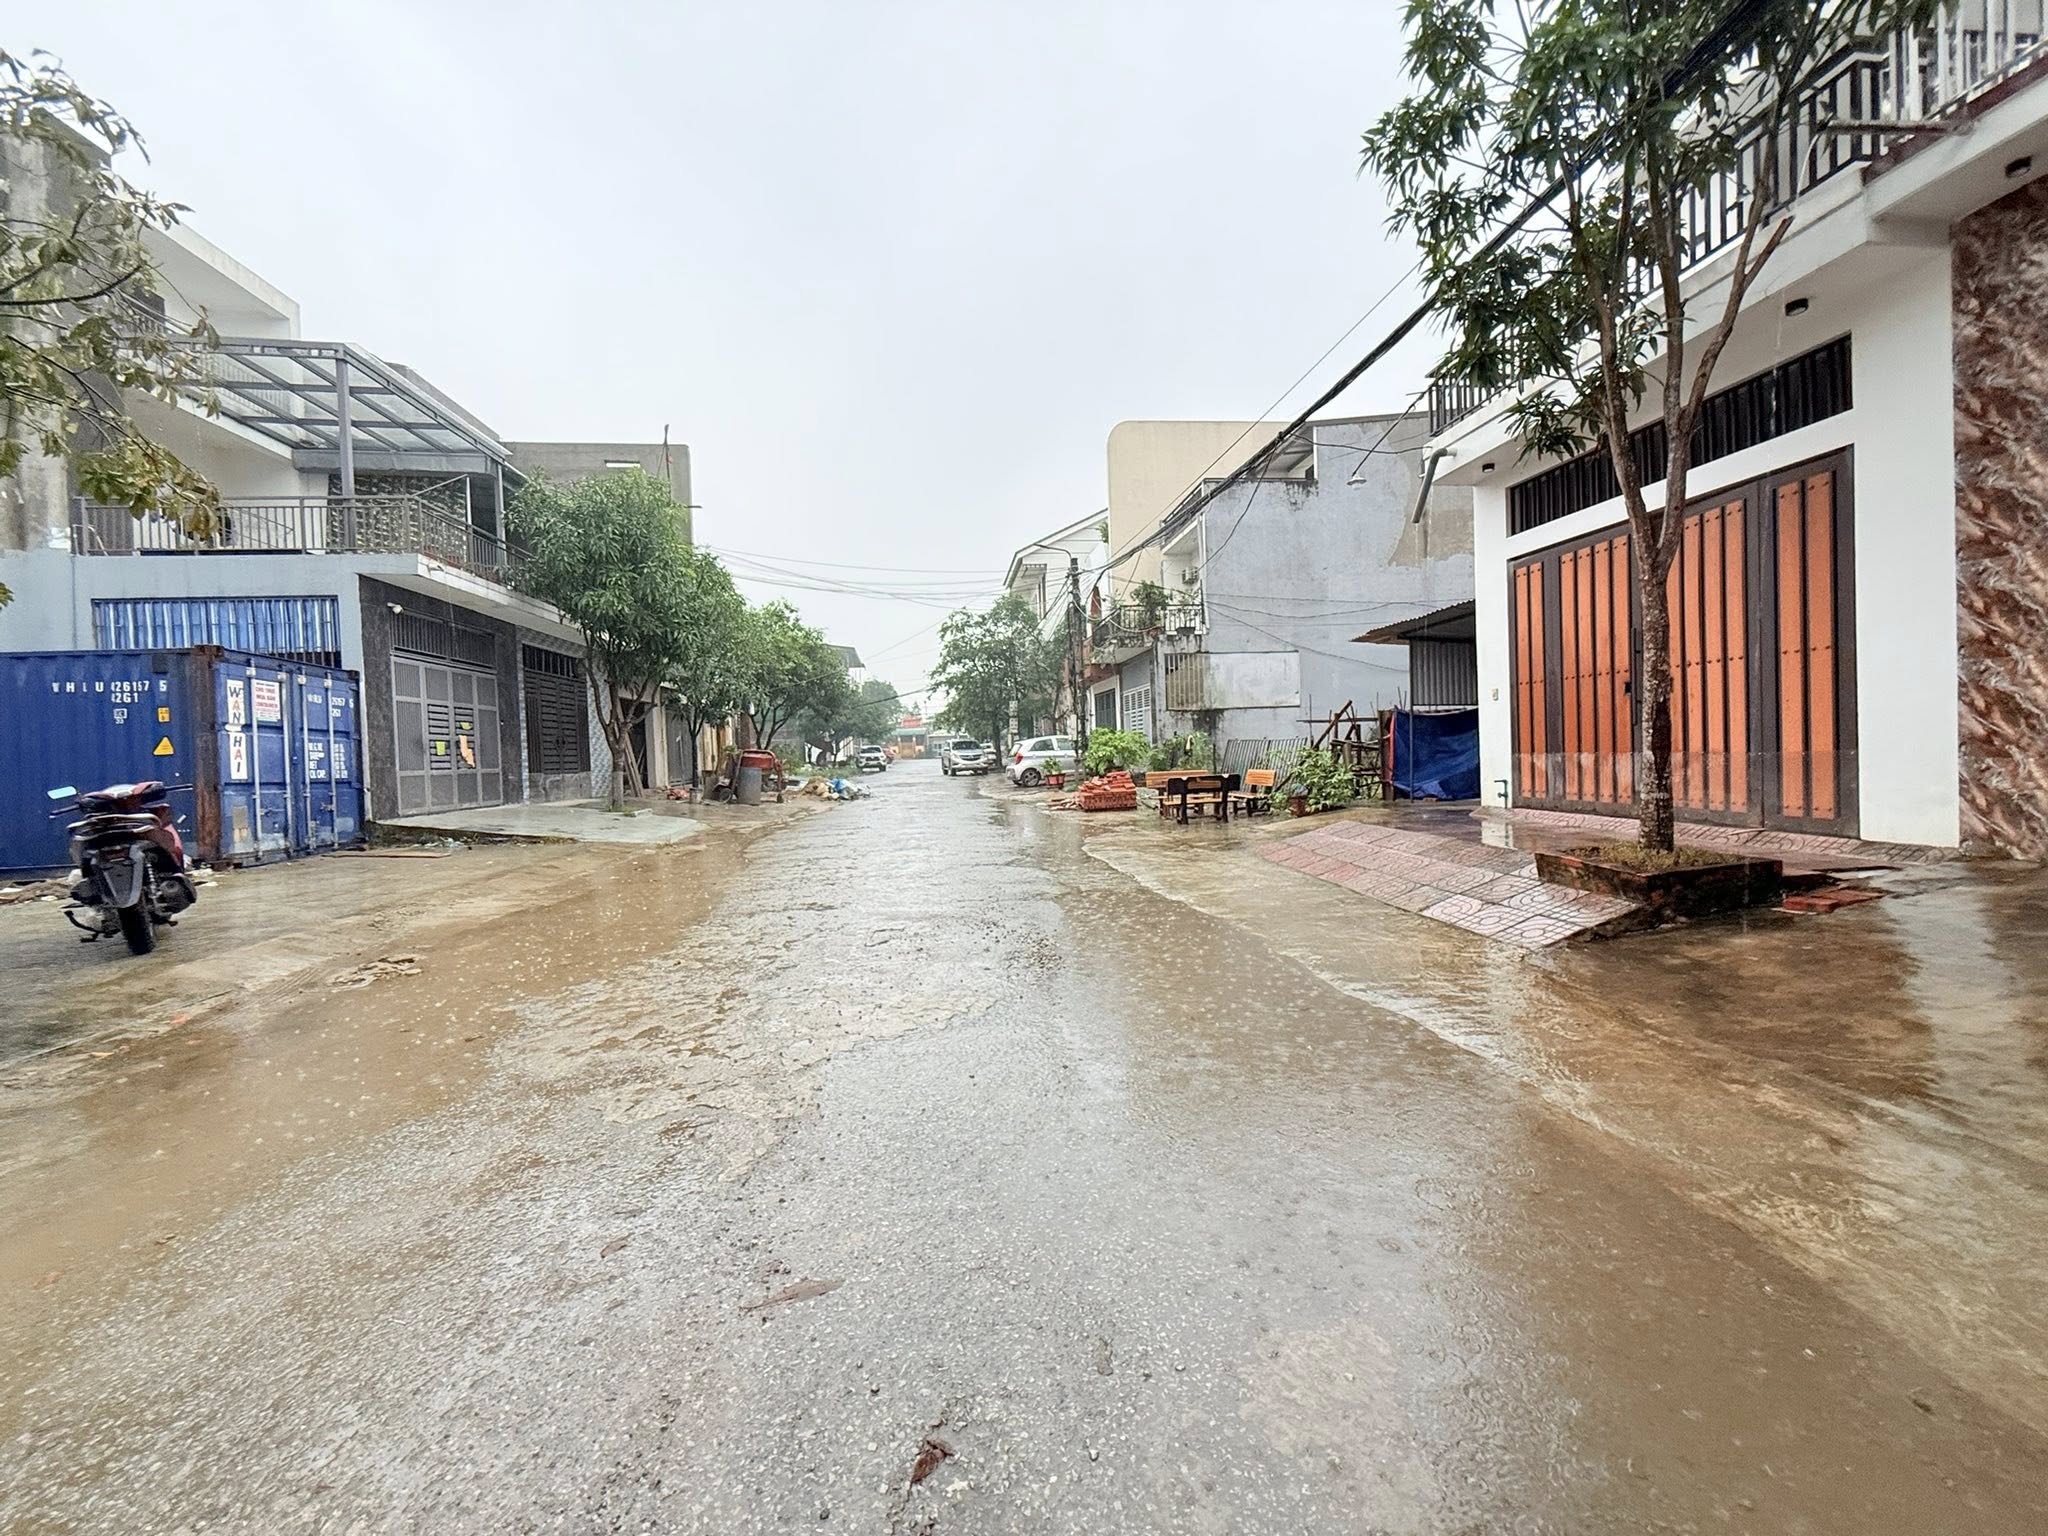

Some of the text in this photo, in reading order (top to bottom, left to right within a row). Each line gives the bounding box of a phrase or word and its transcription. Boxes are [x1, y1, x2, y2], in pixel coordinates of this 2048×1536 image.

[159, 680, 167, 692] 5
[229, 686, 243, 773] WAN HAI
